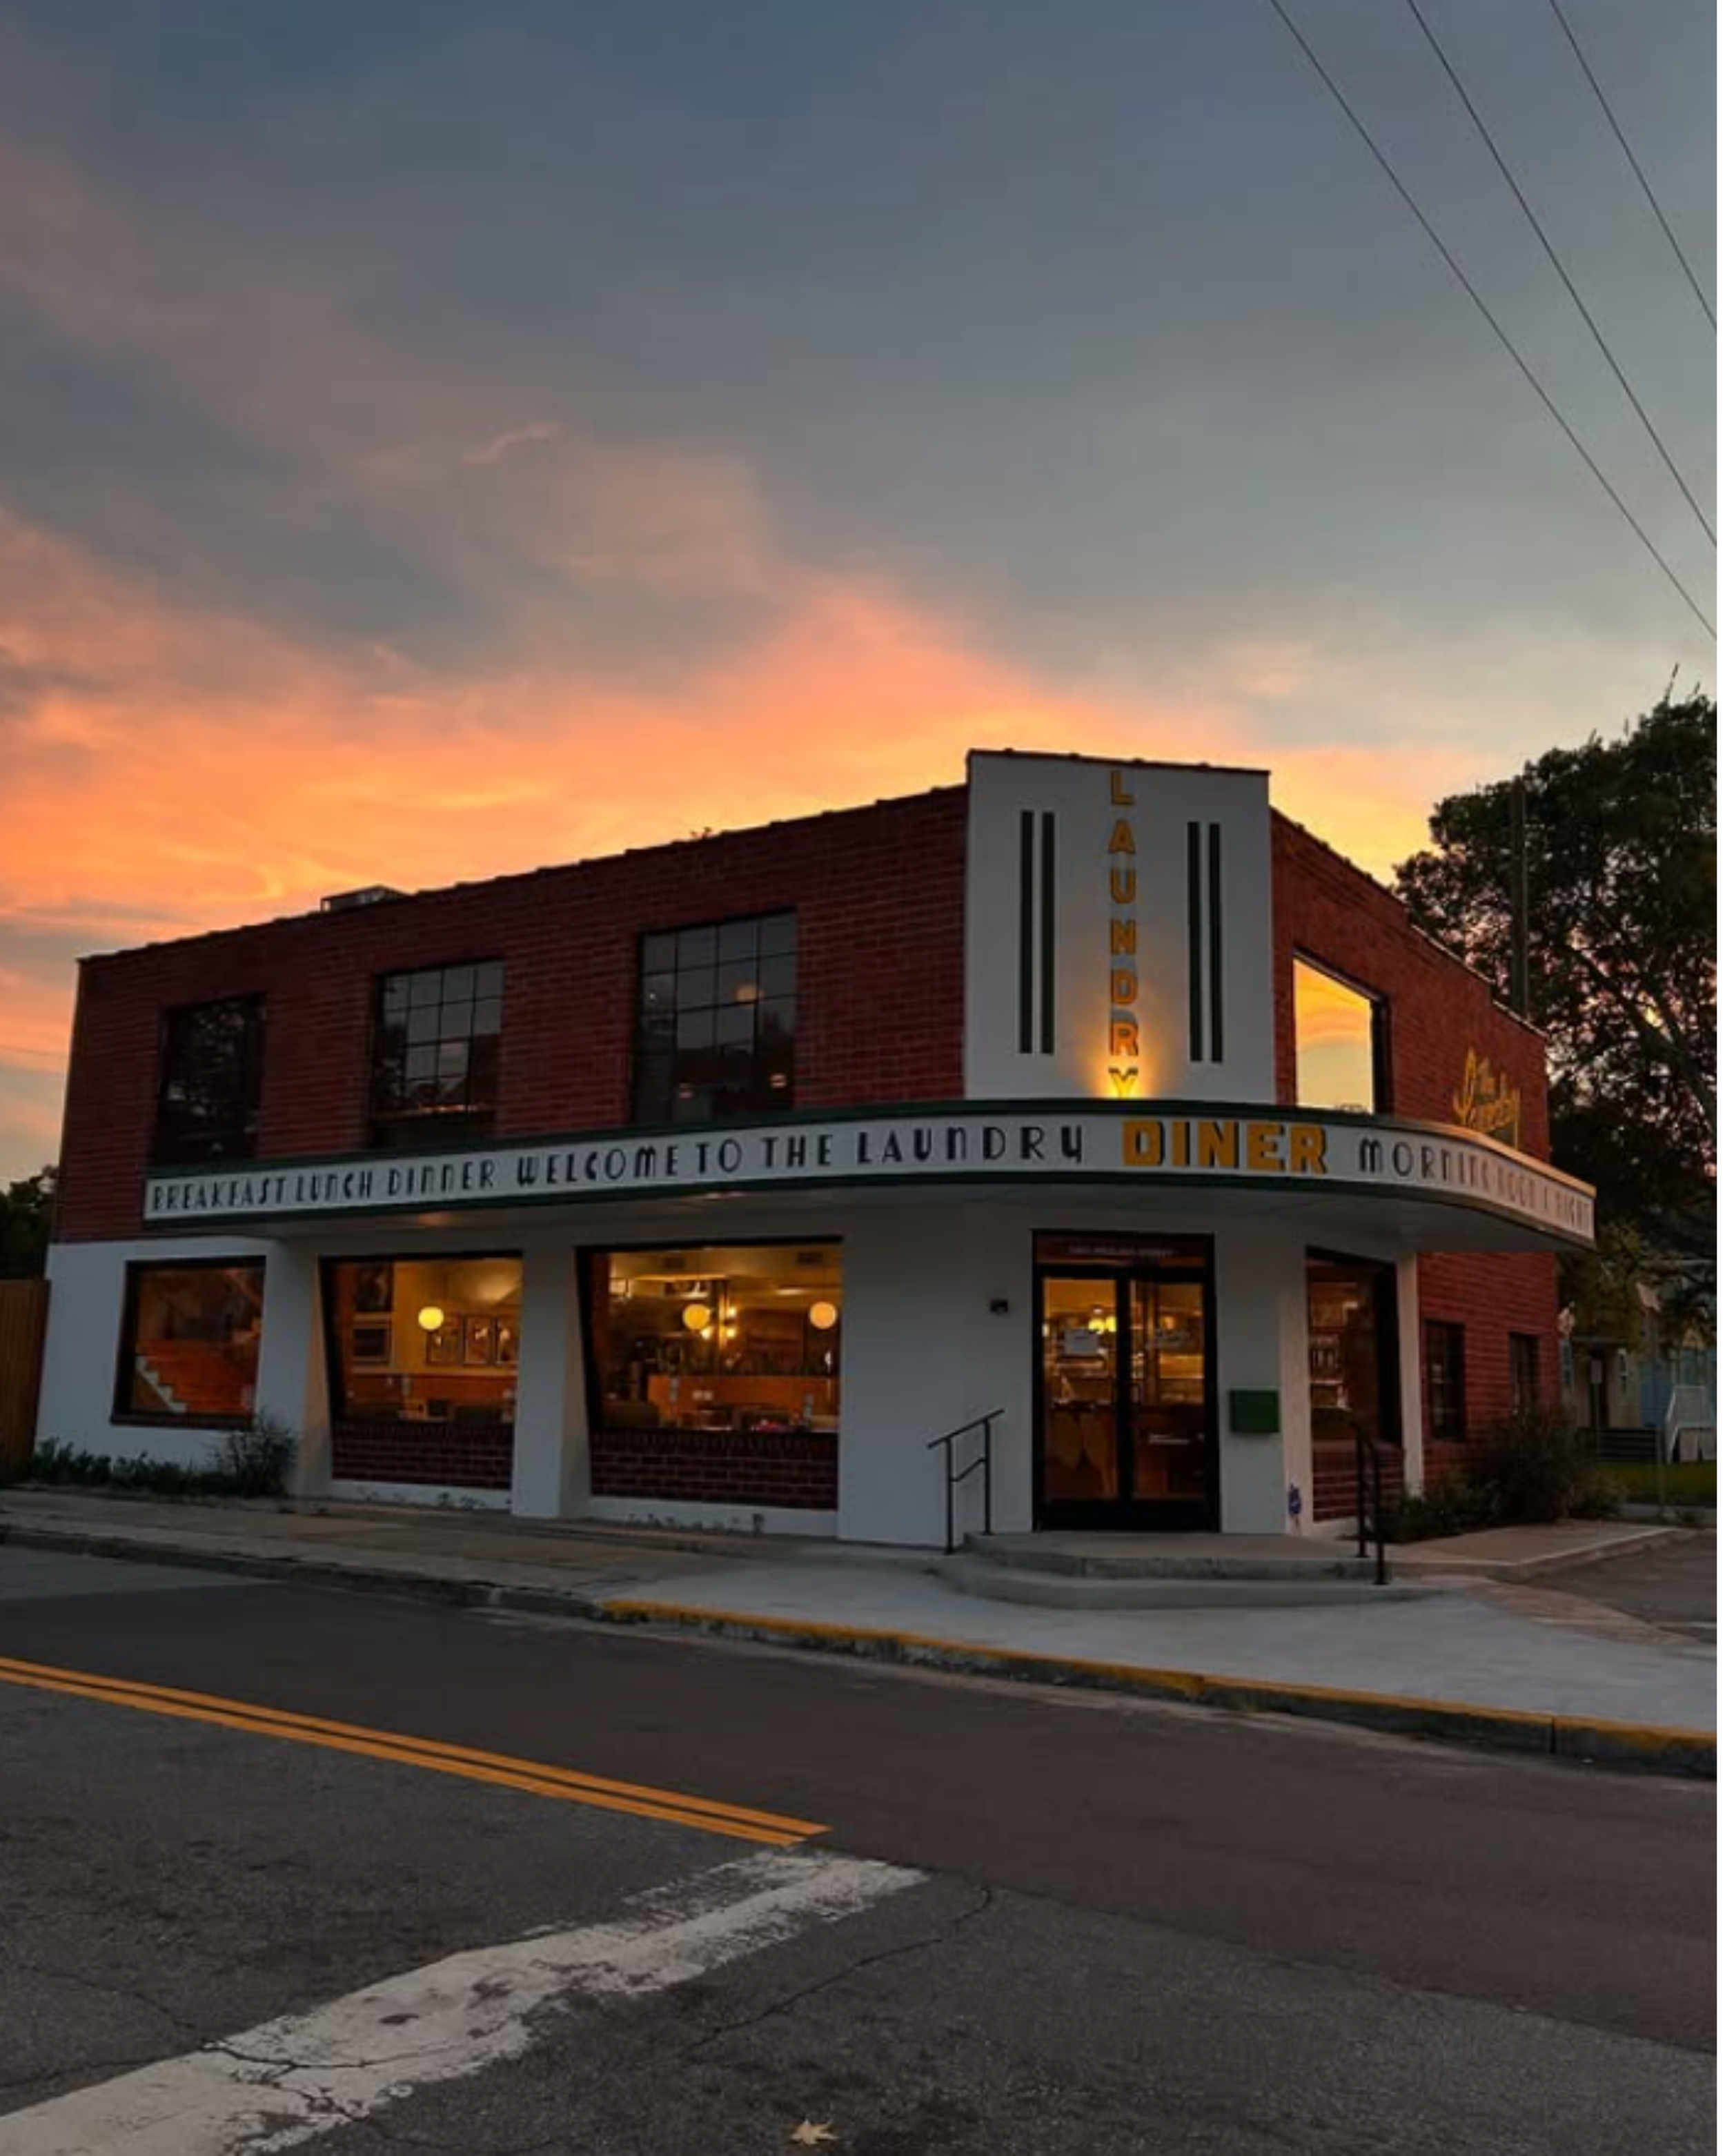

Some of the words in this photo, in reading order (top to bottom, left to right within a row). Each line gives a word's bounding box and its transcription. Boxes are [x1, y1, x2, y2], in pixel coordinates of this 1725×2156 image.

[1109, 770, 1138, 1098] LAUNDRY
[153, 1178, 284, 1209] BREAKFAST
[295, 1169, 373, 1202] LUNCH
[388, 1160, 493, 1194] DINNER
[516, 1145, 678, 1186] WELCOME
[696, 1138, 742, 1173] TO
[762, 1134, 833, 1167] THE
[857, 1126, 1082, 1165] LAUNDRY
[1121, 1119, 1326, 1174] DINER
